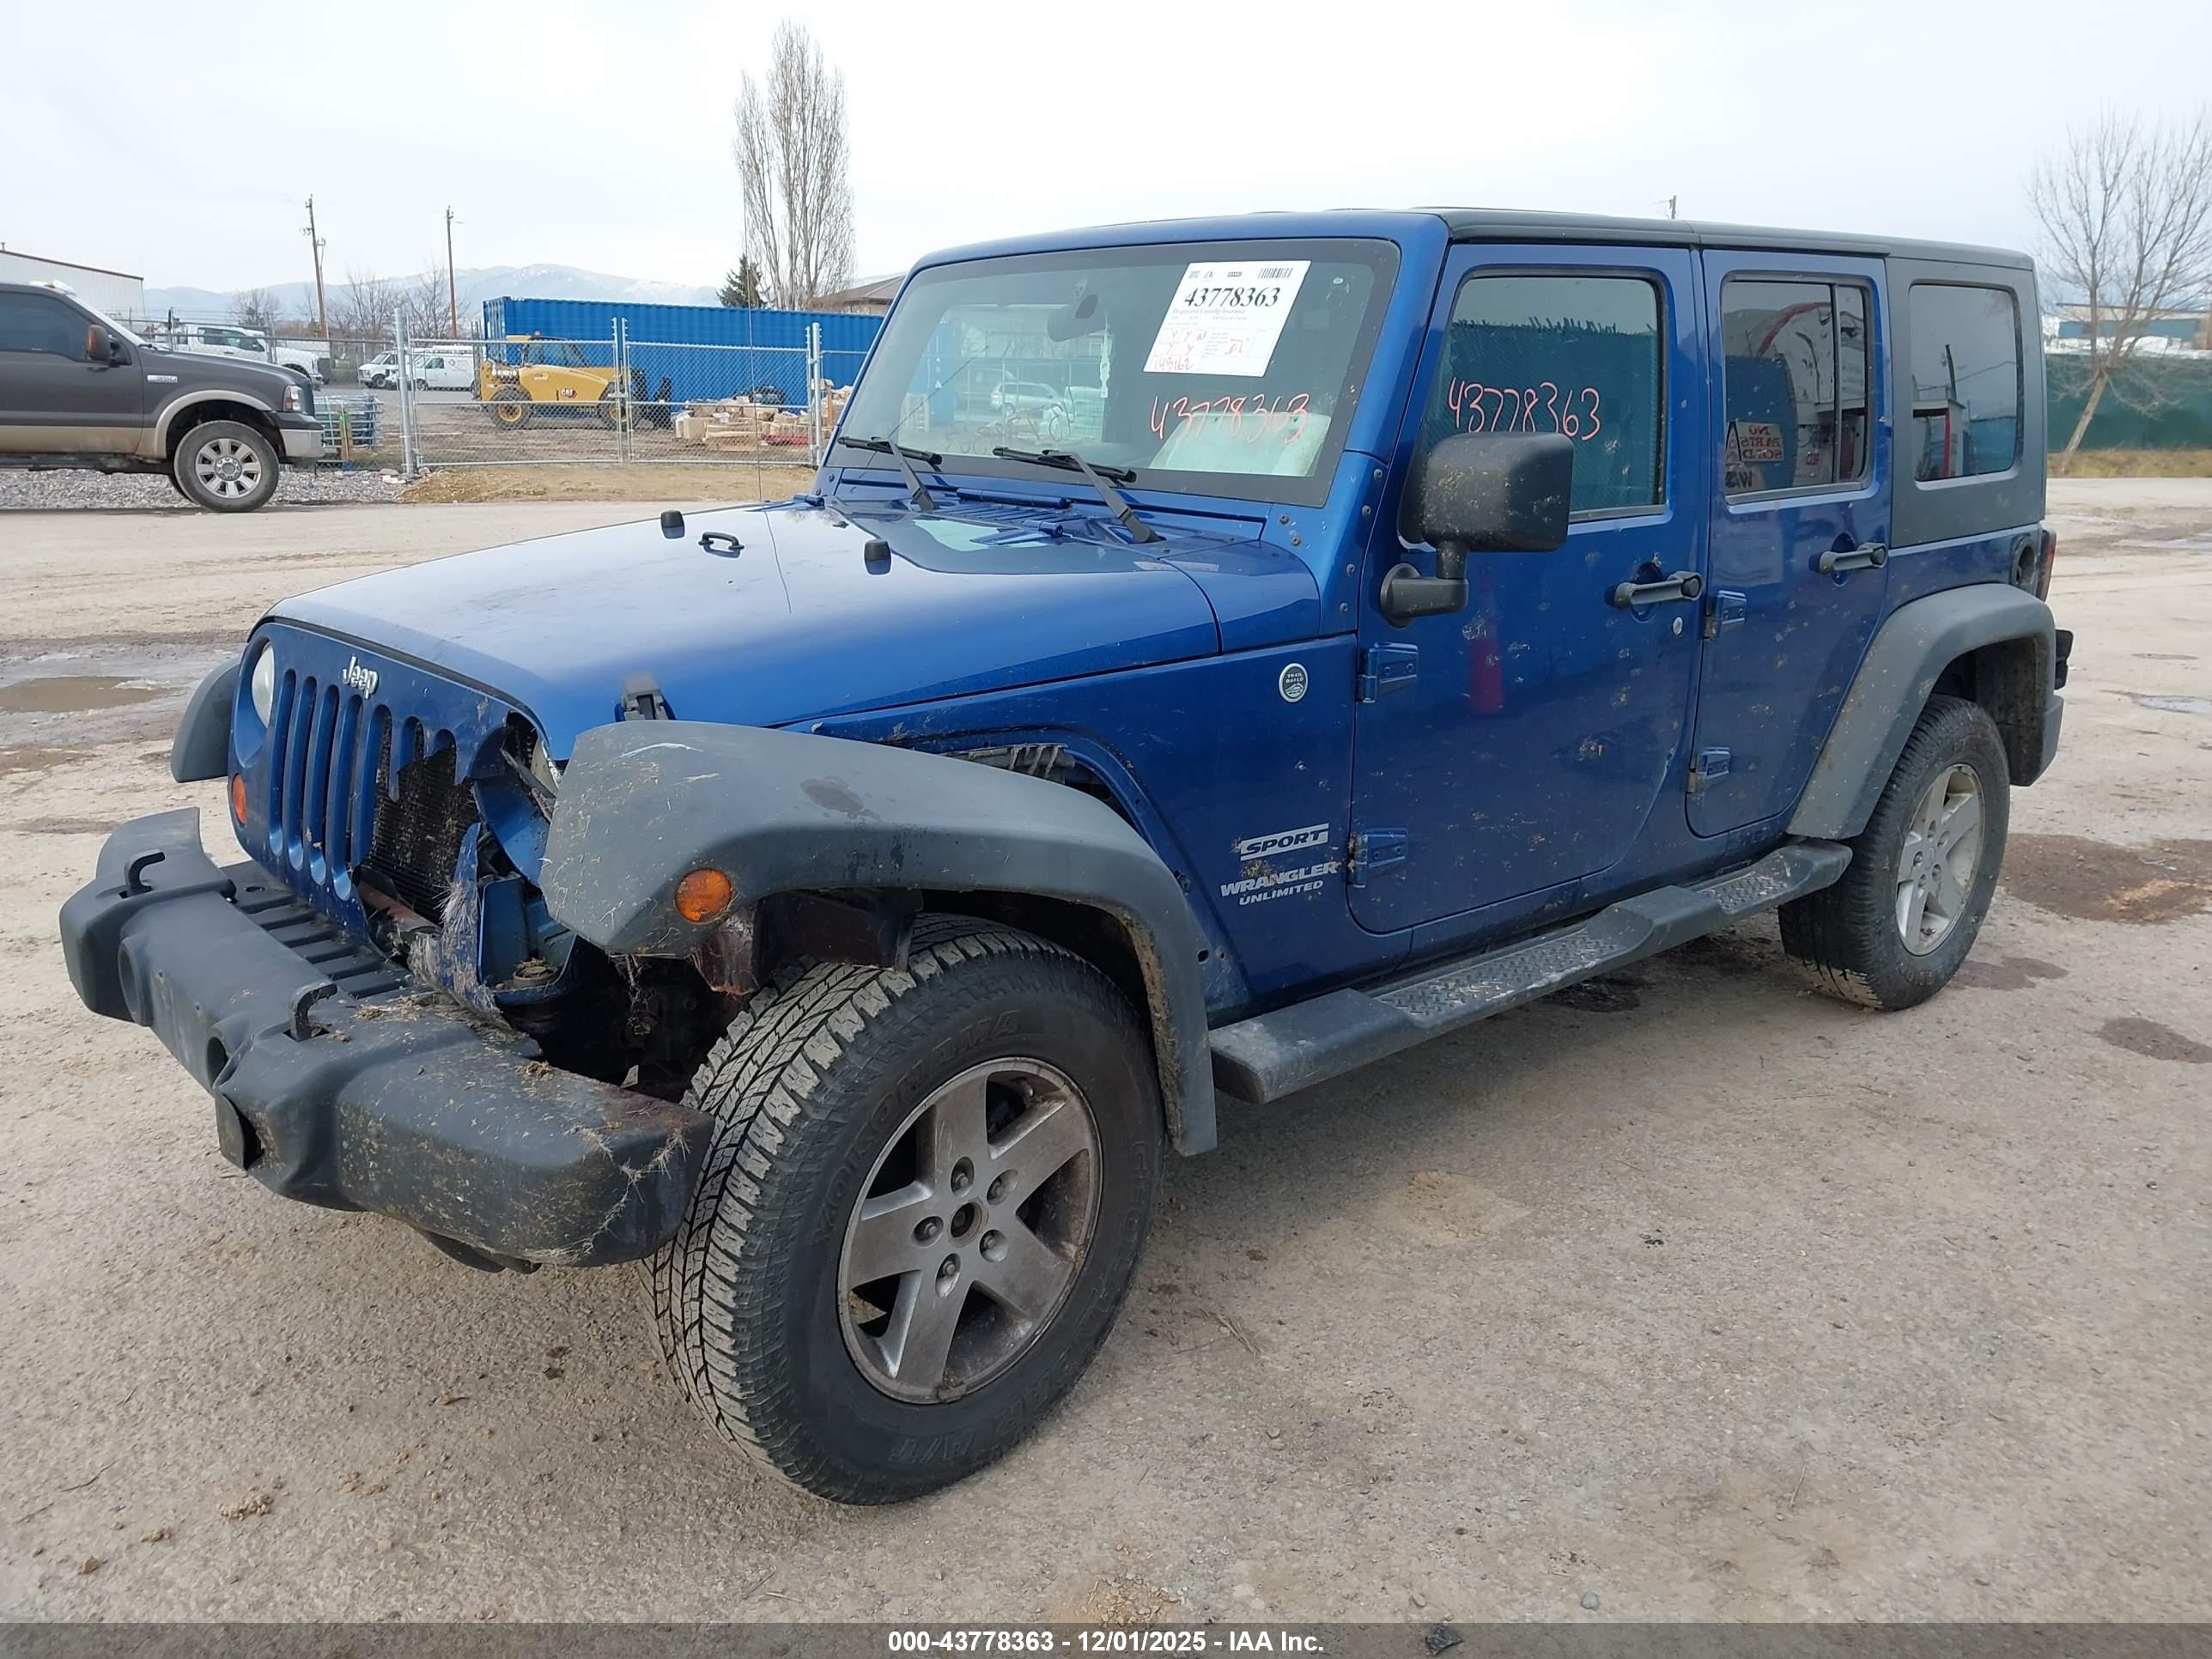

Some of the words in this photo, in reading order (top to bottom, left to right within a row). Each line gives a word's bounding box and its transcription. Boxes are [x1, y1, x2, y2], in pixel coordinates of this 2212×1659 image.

[1185, 287, 1280, 307] 43778363
[1149, 393, 1310, 445] 43778363
[1449, 376, 1600, 441] 43778363
[343, 655, 378, 700] Jeep
[1246, 830, 1326, 853] SPORT
[1220, 860, 1340, 896] WRANGLER
[1239, 880, 1324, 906] UNLIMITED
